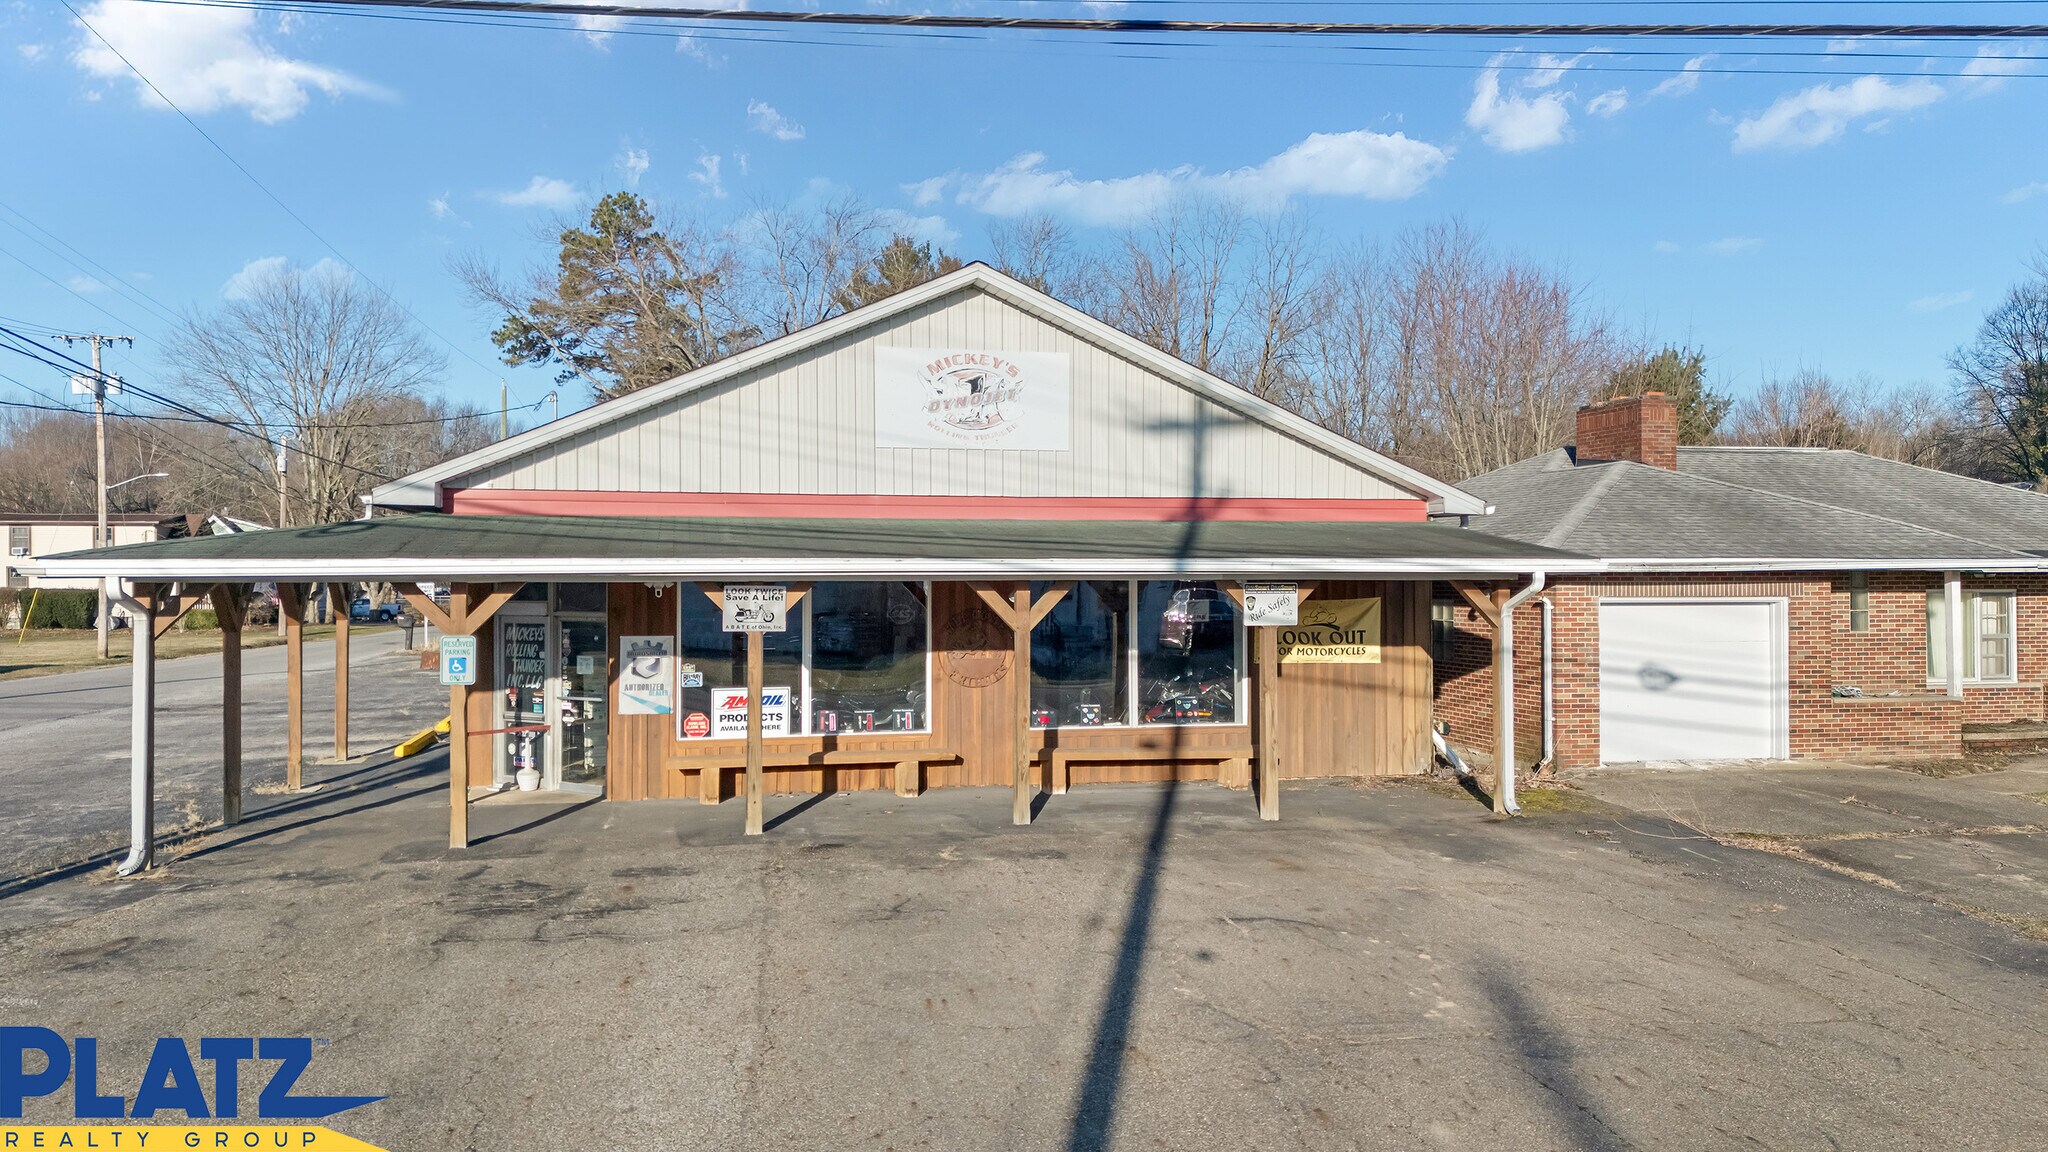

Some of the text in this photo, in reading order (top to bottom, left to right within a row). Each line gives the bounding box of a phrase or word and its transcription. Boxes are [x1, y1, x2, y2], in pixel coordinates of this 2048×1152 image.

[926, 353, 1020, 378] MICKEY'S
[927, 388, 1017, 412] DYNOJET
[1249, 594, 1291, 622] Ride Safely
[1329, 629, 1367, 646] OUT
[505, 643, 539, 658] ROLLING
[1277, 646, 1366, 656] OR MOTORCYCLES
[512, 659, 545, 673] THUNDER
[624, 683, 664, 691] AUTHORIZED
[721, 695, 784, 710] AMOIL
